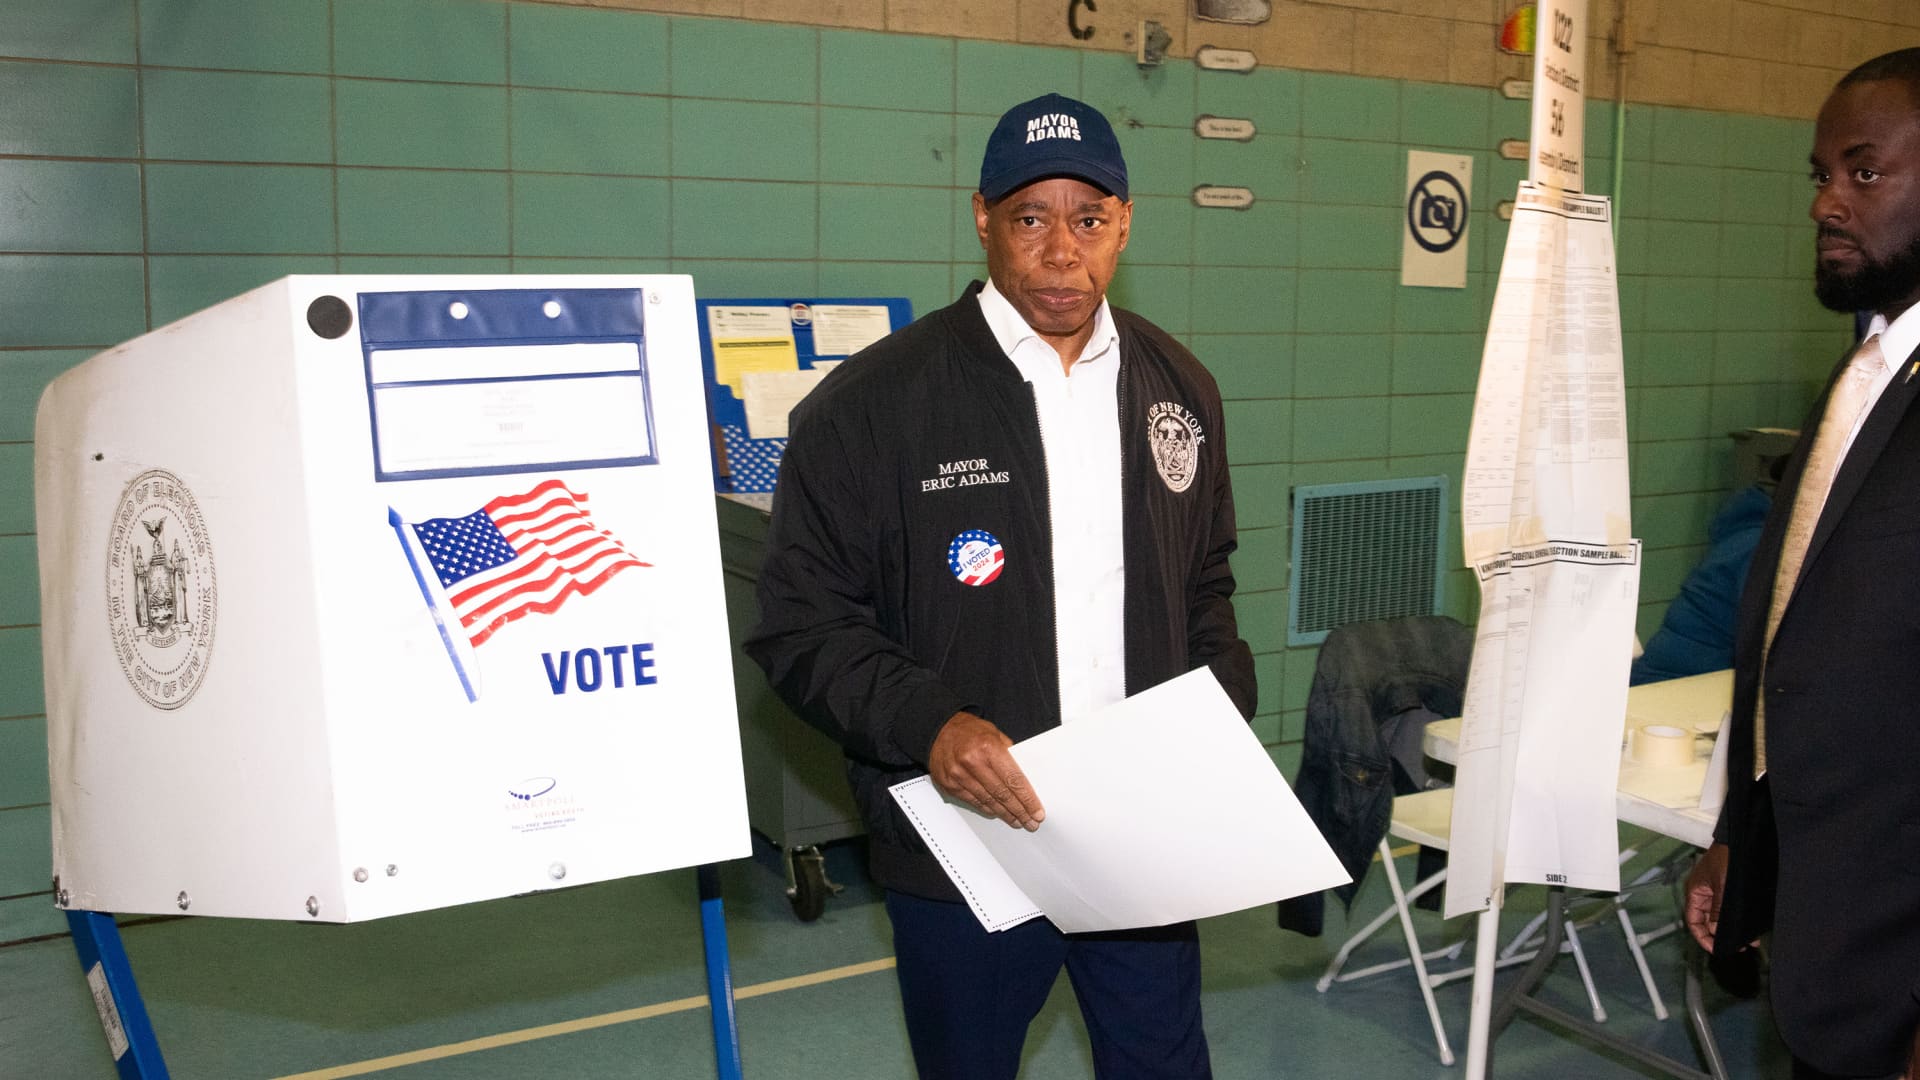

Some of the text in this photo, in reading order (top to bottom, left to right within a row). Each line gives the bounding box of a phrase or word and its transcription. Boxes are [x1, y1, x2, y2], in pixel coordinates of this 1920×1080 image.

[1027, 113, 1078, 131] MAYOR
[1025, 126, 1082, 144] ADAMS
[1149, 402, 1206, 446] OF NEW YORK
[938, 458, 990, 475] MAYOR
[921, 471, 1010, 492] ERIC ADAMS
[111, 500, 135, 568] BOARD
[135, 483, 149, 505] OF
[966, 547, 991, 566] VOTED
[1580, 549, 1608, 559] SAMPLE
[541, 642, 658, 695] VOTE
[134, 665, 161, 697] CITY
[162, 681, 177, 699] OF
[1546, 873, 1568, 883] SIDE 2
